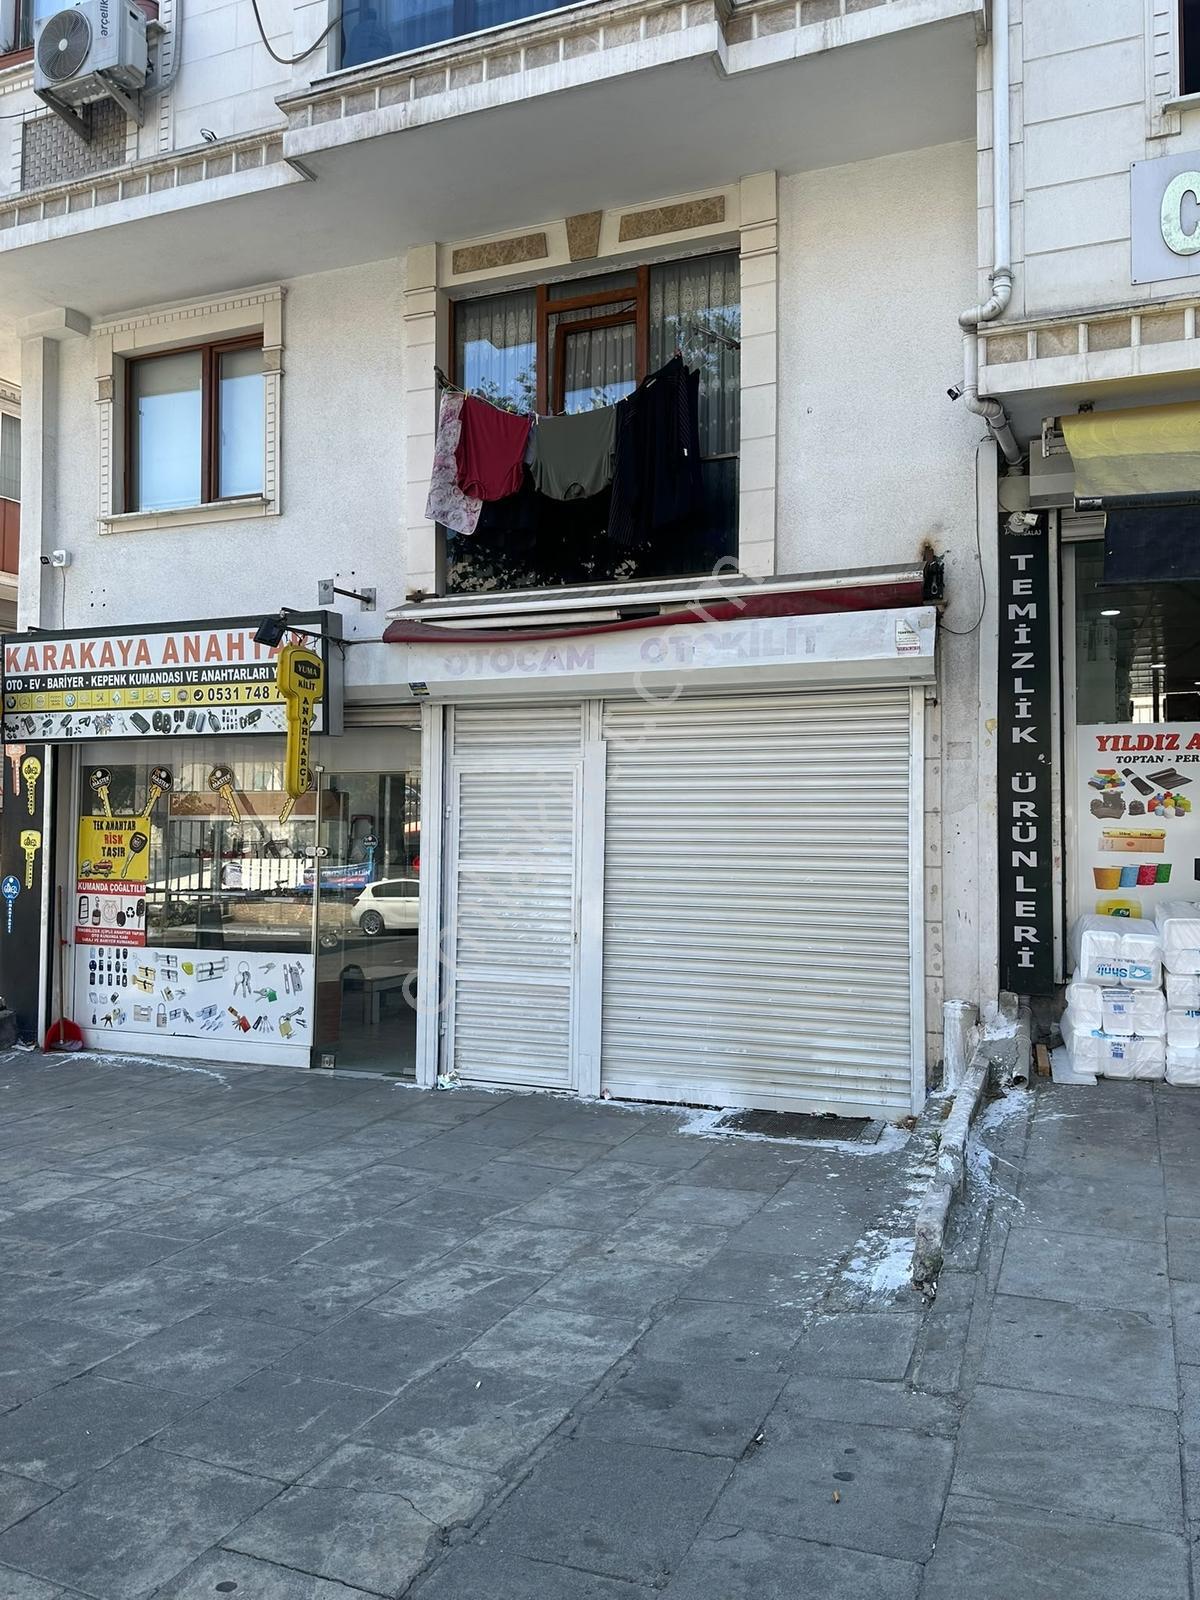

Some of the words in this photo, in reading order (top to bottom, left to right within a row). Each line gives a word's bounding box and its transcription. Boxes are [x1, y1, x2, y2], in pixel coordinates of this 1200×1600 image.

[6, 638, 151, 673] KARAKAYA
[1008, 554, 1038, 744] TEMİZLİK
[443, 643, 596, 676] OTOCAM
[297, 664, 318, 677] YUMA
[6, 679, 23, 691] OTO
[29, 678, 41, 690] EV
[47, 674, 84, 689] BARİYER
[91, 673, 127, 687] KEPENK
[129, 671, 184, 685] KUMANDASI
[186, 670, 199, 683] VE
[201, 667, 269, 682] ANAHTARLARI
[298, 678, 317, 691] KİLİT
[208, 686, 239, 701] 0531
[245, 685, 270, 700] 748
[301, 696, 310, 787] ANAHTARCI
[1096, 733, 1180, 752] YILDIZ
[1115, 755, 1164, 764] TOPTAN
[151, 774, 170, 788] MASTER
[93, 820, 104, 831] TEK
[105, 820, 136, 831] ANAHTAR
[104, 832, 123, 844] RİSK
[101, 846, 126, 858] TAŞIR
[1011, 772, 1040, 968] ÜRÜNLERİ
[77, 881, 109, 892] KUMANDA
